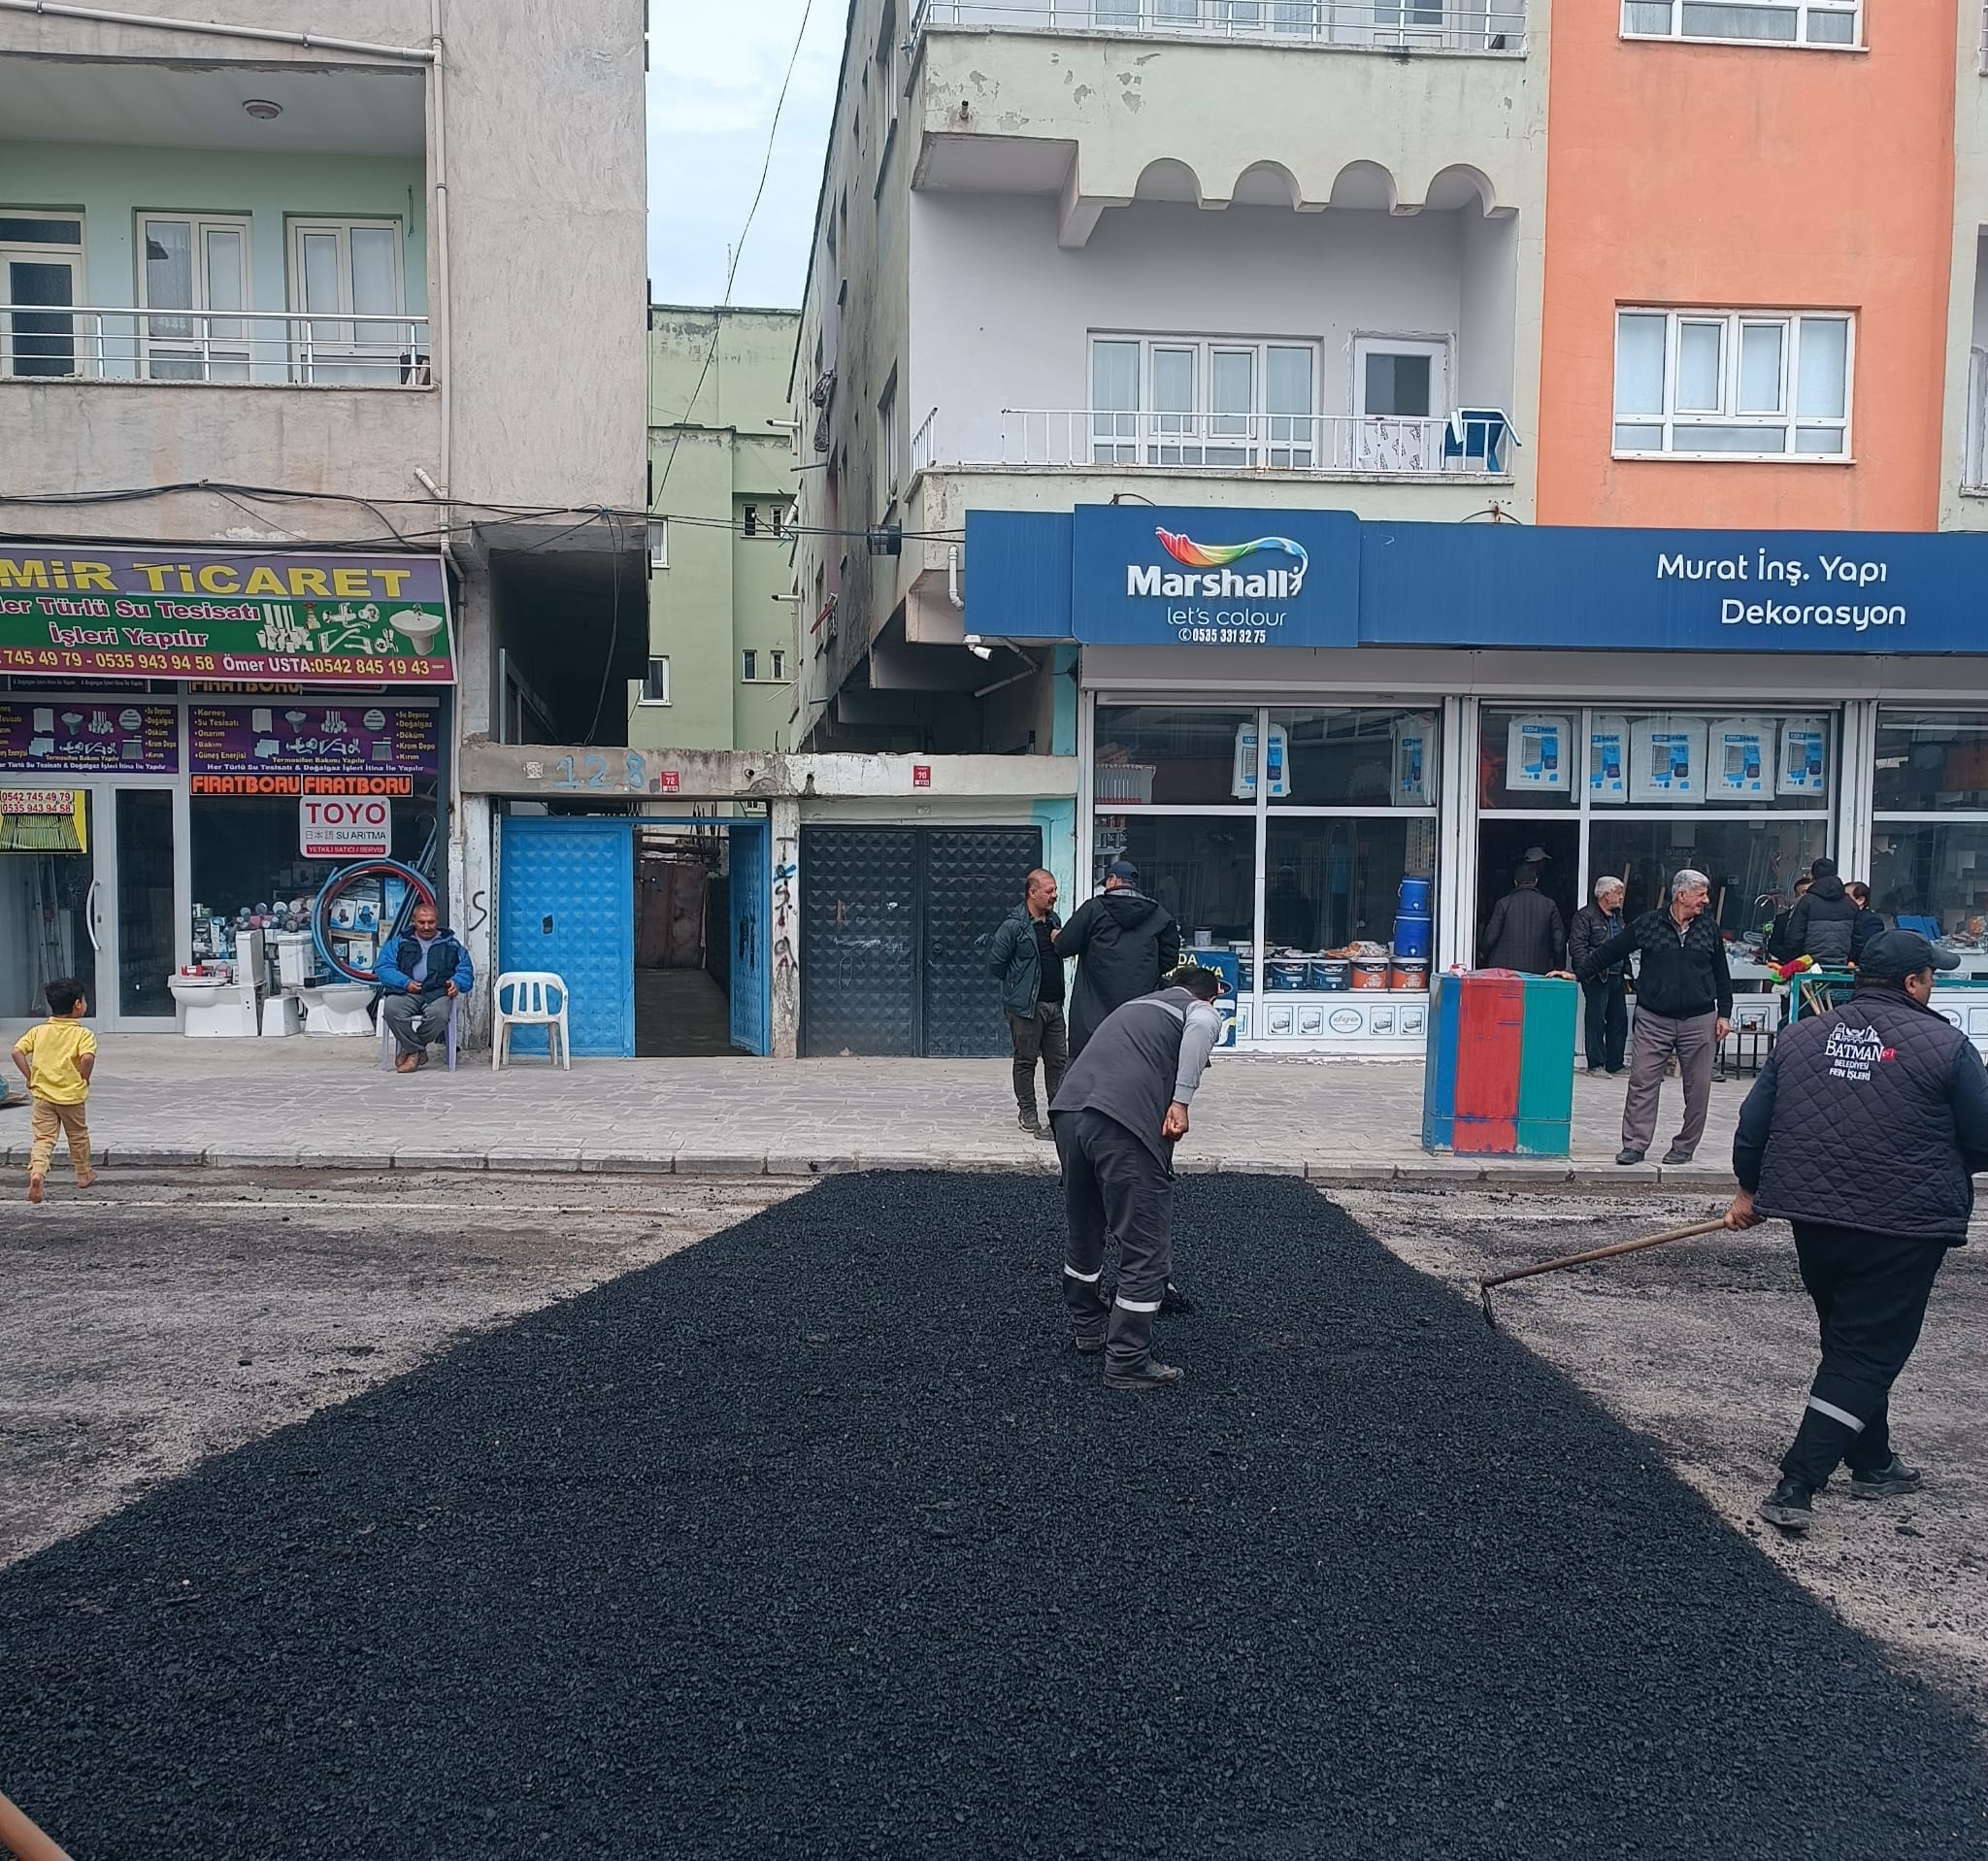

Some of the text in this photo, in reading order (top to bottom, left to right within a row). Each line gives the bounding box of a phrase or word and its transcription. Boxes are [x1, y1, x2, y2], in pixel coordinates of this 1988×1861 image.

[1657, 548, 1887, 586] Murat İnş. Yapı
[1127, 565, 1288, 597] Marshall
[36, 597, 110, 617] Türlü
[115, 599, 151, 618] Su
[155, 600, 261, 621] Tesisatı
[1216, 608, 1287, 626] colour
[1721, 598, 1906, 631] Dekorasyon
[49, 622, 209, 649] İşleri Yapılır
[1220, 629, 1238, 643] 331
[1239, 629, 1251, 643] 32
[1254, 630, 1266, 643] 75
[3, 649, 34, 665] 745
[38, 650, 58, 666] 49
[61, 651, 83, 667] 79
[95, 652, 135, 668] 0535
[138, 653, 168, 669] 943
[171, 654, 191, 670] 94
[195, 655, 215, 671] 58
[222, 653, 265, 672] Ömer
[355, 658, 383, 675] 845
[388, 659, 407, 675] 19
[411, 660, 430, 675] 43
[192, 776, 300, 793] FIRATBORU
[304, 777, 411, 794] FIRATBORU
[2, 792, 70, 801] 0542 745 49 79
[2, 804, 71, 813] 0535 943 94 58
[305, 803, 386, 824] TOYO
[1825, 1040, 1884, 1062] BATMAN
[1834, 1058, 1870, 1070] BELEDİYESİ
[1829, 1068, 1871, 1080] FEN İŞLERİ
